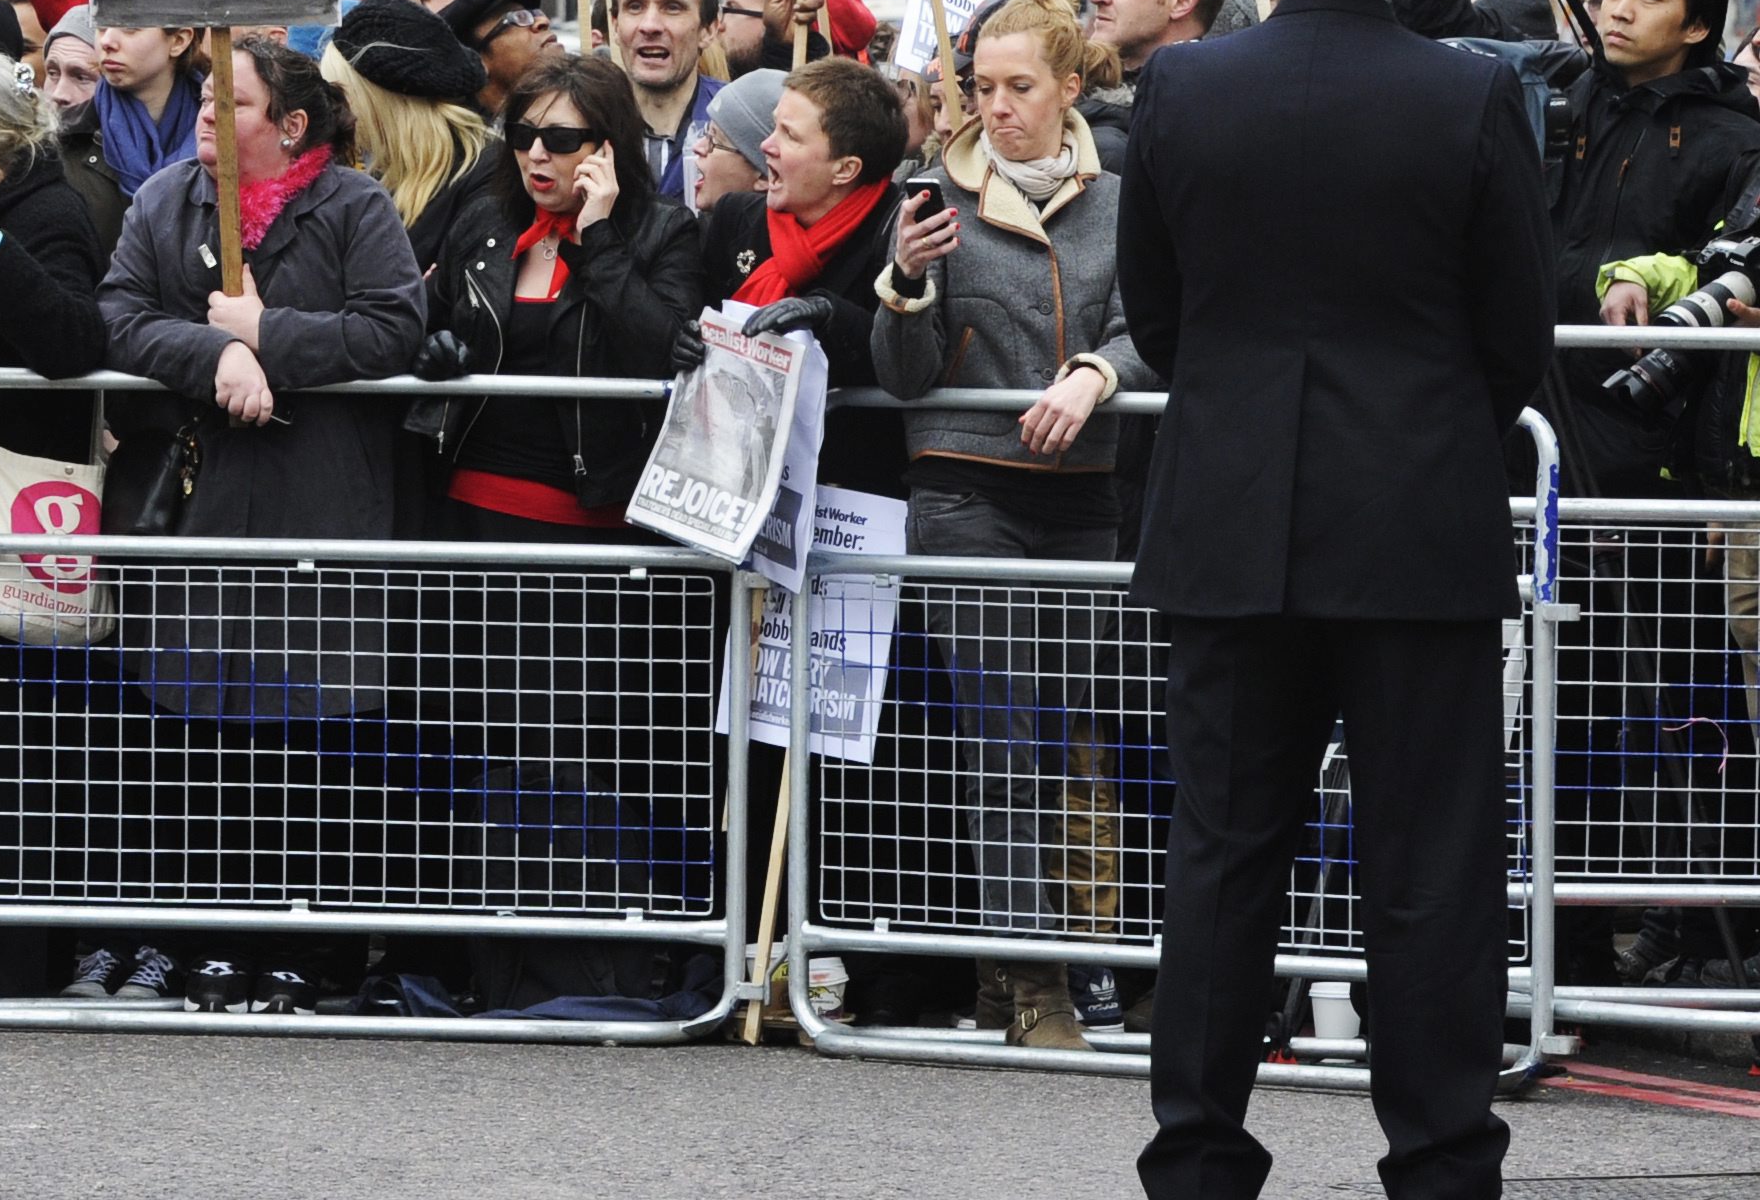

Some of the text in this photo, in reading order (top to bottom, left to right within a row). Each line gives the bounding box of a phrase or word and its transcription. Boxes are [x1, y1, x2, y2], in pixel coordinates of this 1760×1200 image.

[701, 324, 791, 369] ocialist Worker
[641, 463, 756, 532] REJOICE!
[829, 506, 867, 526] Worker
